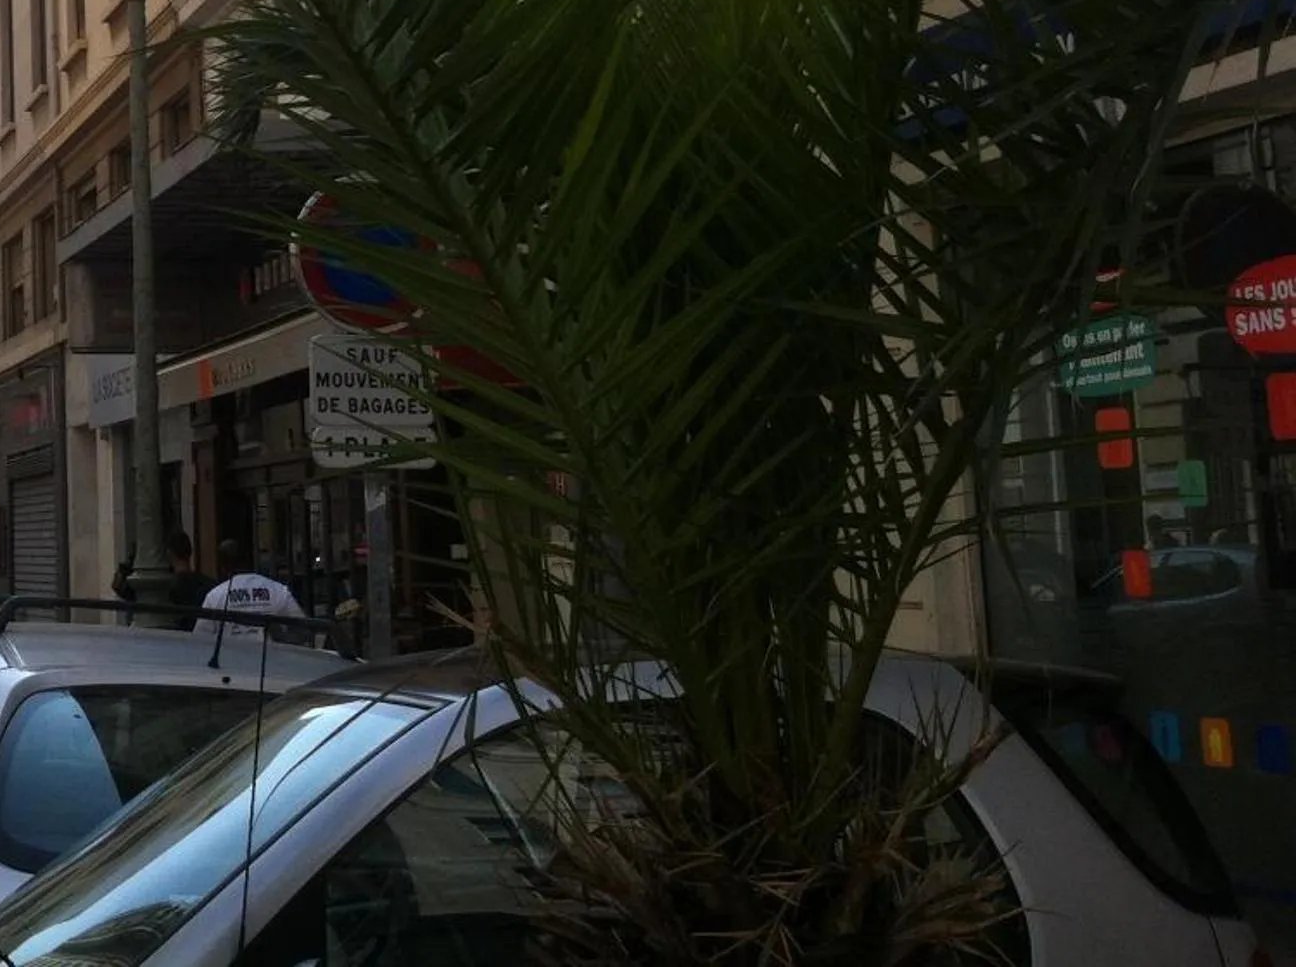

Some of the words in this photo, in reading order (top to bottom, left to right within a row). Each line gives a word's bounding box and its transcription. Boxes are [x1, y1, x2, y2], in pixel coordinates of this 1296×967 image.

[1235, 307, 1286, 336] SANS
[346, 347, 398, 364] SAUF
[317, 397, 341, 413] DE
[348, 397, 429, 415] BAGAGES
[345, 436, 428, 459] PLA
